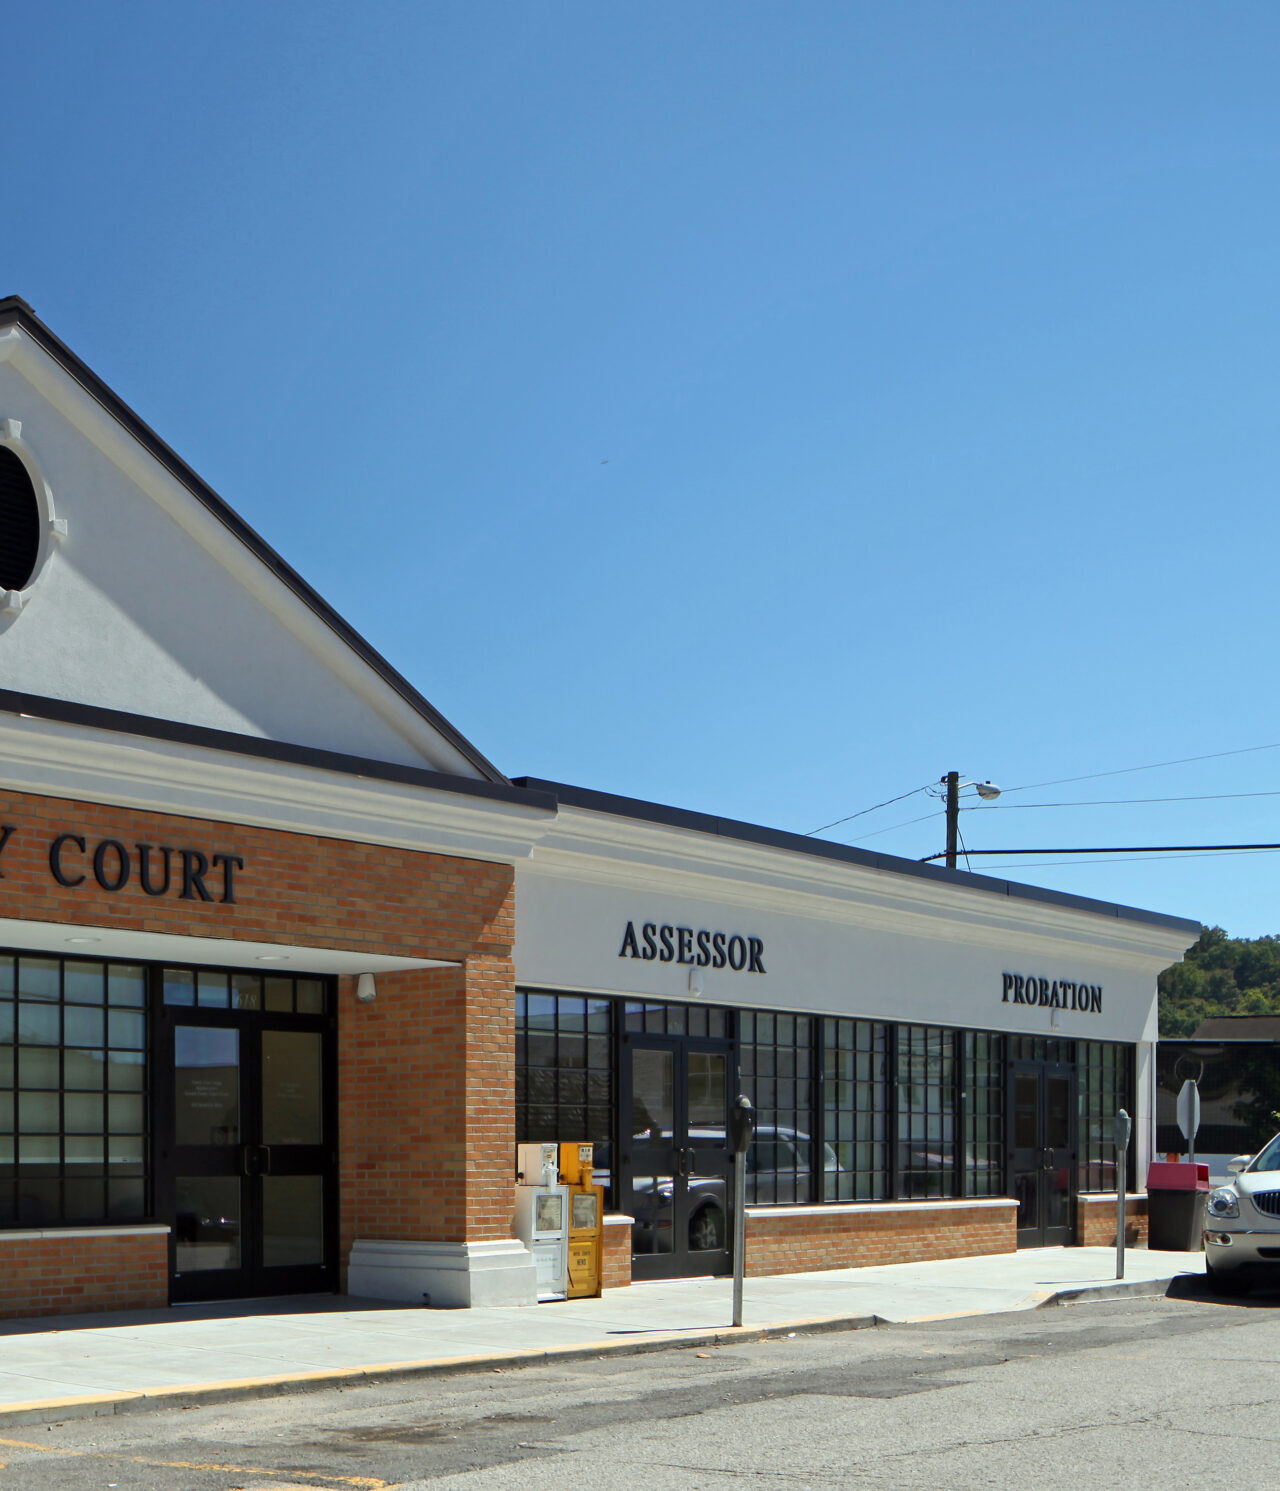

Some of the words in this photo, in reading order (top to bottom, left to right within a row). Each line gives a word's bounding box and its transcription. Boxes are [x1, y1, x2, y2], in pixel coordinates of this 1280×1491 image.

[49, 833, 244, 905] COURT
[618, 920, 767, 974] ASSESSOR
[1001, 972, 1104, 1014] PROBATION
